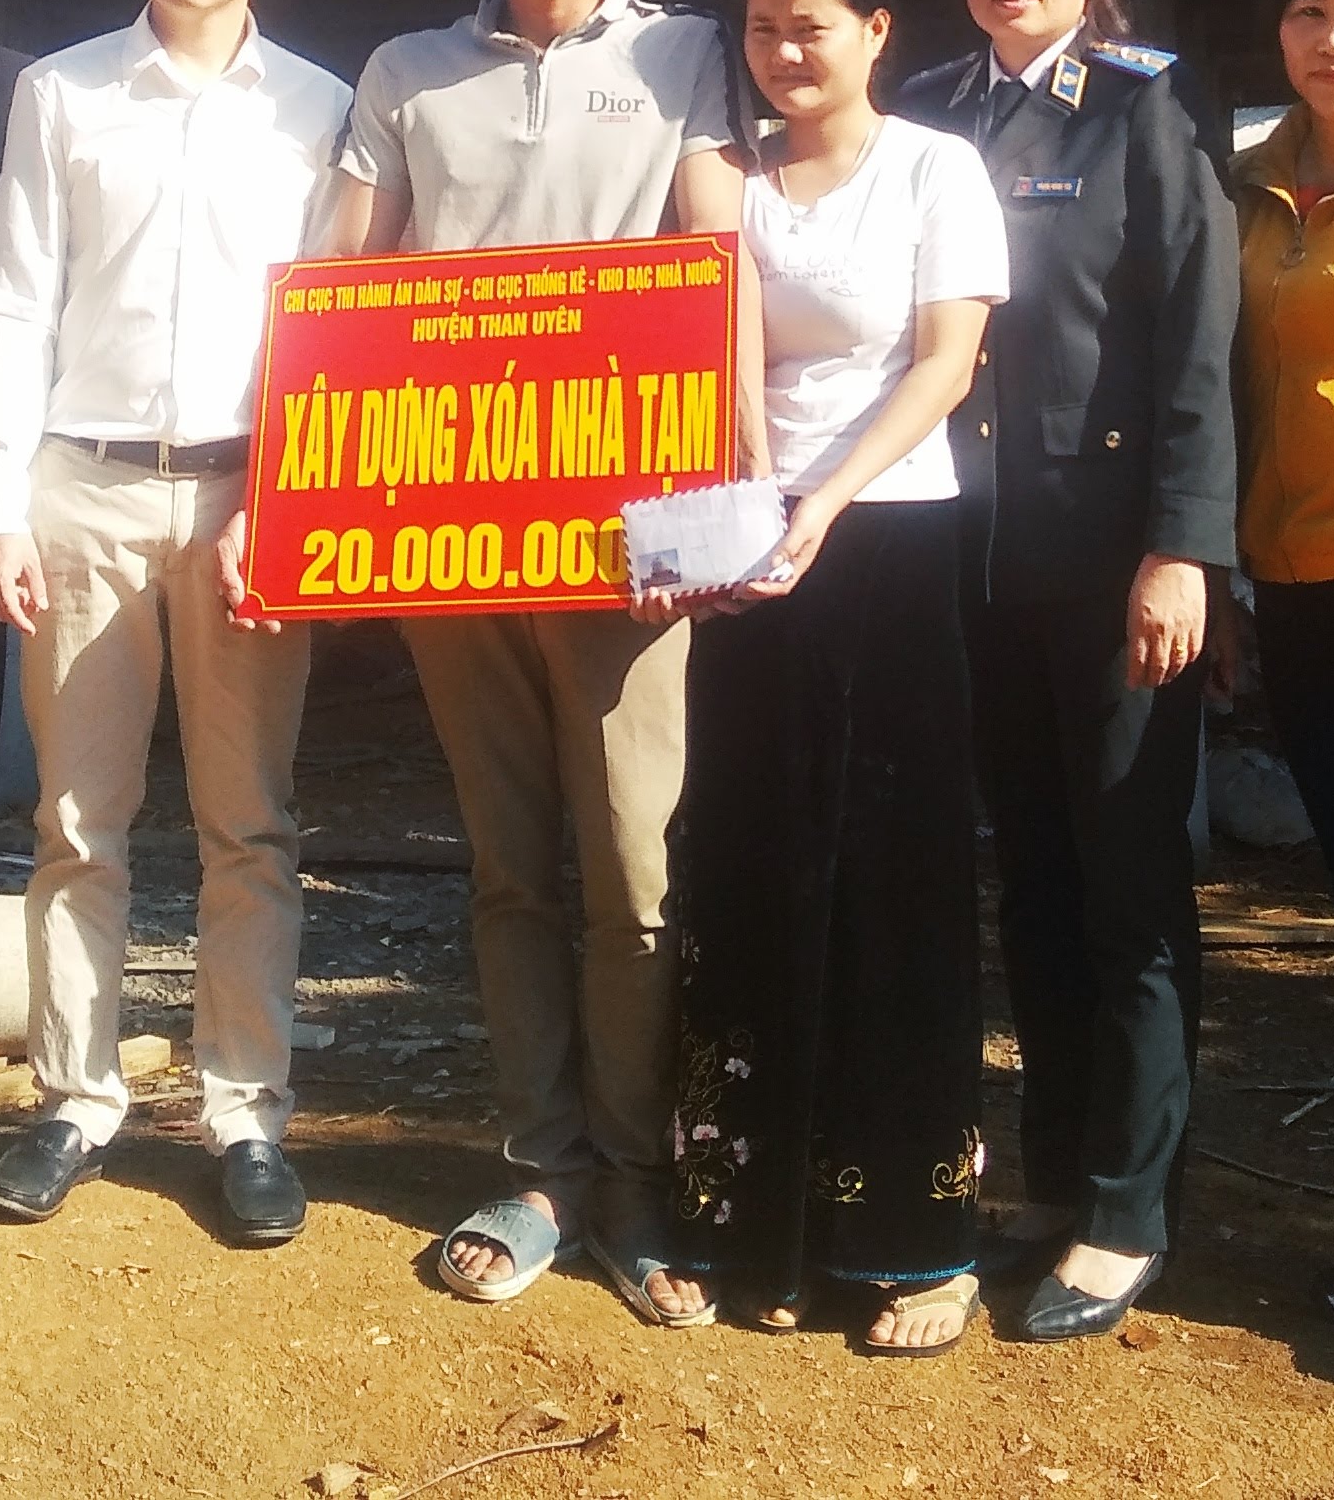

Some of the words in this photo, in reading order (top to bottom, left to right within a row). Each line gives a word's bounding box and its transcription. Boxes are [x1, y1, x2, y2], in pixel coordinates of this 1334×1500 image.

[585, 90, 646, 113] Dior
[283, 287, 307, 314] CHI
[306, 286, 334, 316] CỤC
[335, 285, 356, 311] THI
[356, 279, 393, 310] HÀNH
[393, 278, 413, 307] ÁN
[414, 275, 442, 306] DÂN
[443, 275, 464, 308] SỰ
[472, 276, 495, 302] CHI
[496, 274, 523, 305] CỤC
[524, 264, 568, 298] THỐNG
[569, 265, 587, 295] KÊ
[597, 267, 624, 293] KHO
[626, 265, 654, 295] BẠC
[655, 258, 684, 289] NHÀ
[685, 256, 722, 287] NƯỚC
[412, 311, 474, 345] HUYỆN
[478, 313, 528, 338] THAN
[531, 304, 582, 335] UYÊN
[276, 372, 353, 491] XÂY
[356, 376, 458, 507] DỰNG
[464, 359, 539, 483] XÓA
[549, 354, 626, 479] NHÀ
[637, 370, 718, 495] TẠM
